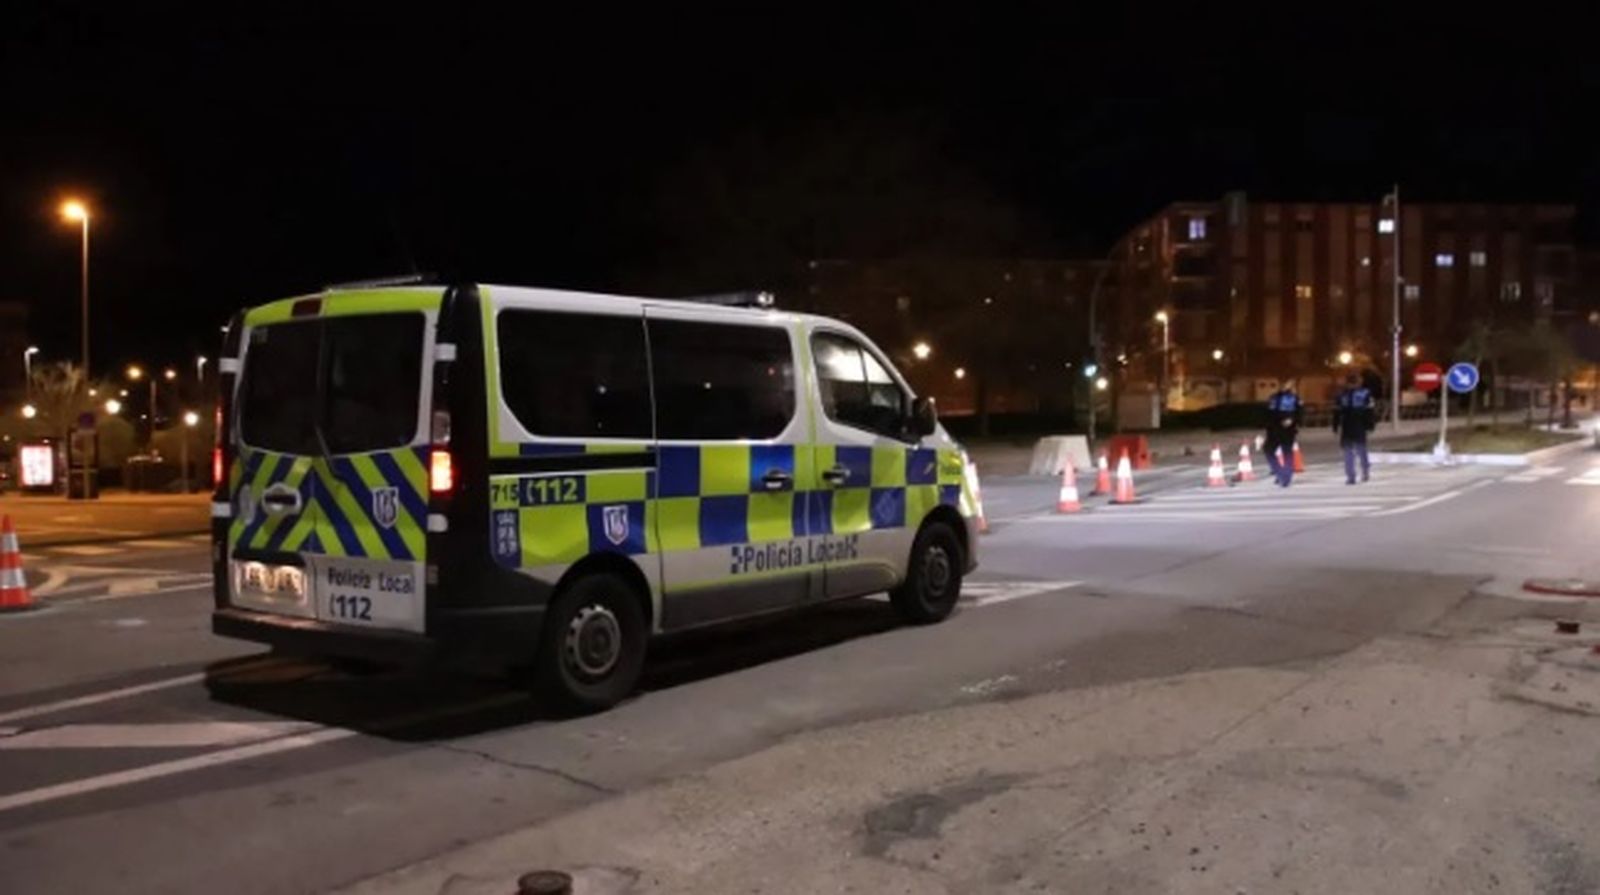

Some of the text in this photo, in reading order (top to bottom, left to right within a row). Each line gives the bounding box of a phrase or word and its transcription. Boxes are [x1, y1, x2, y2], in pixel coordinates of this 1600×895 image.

[491, 484, 518, 503] 715
[744, 534, 850, 572] Policía Local
[378, 571, 415, 594] Local
